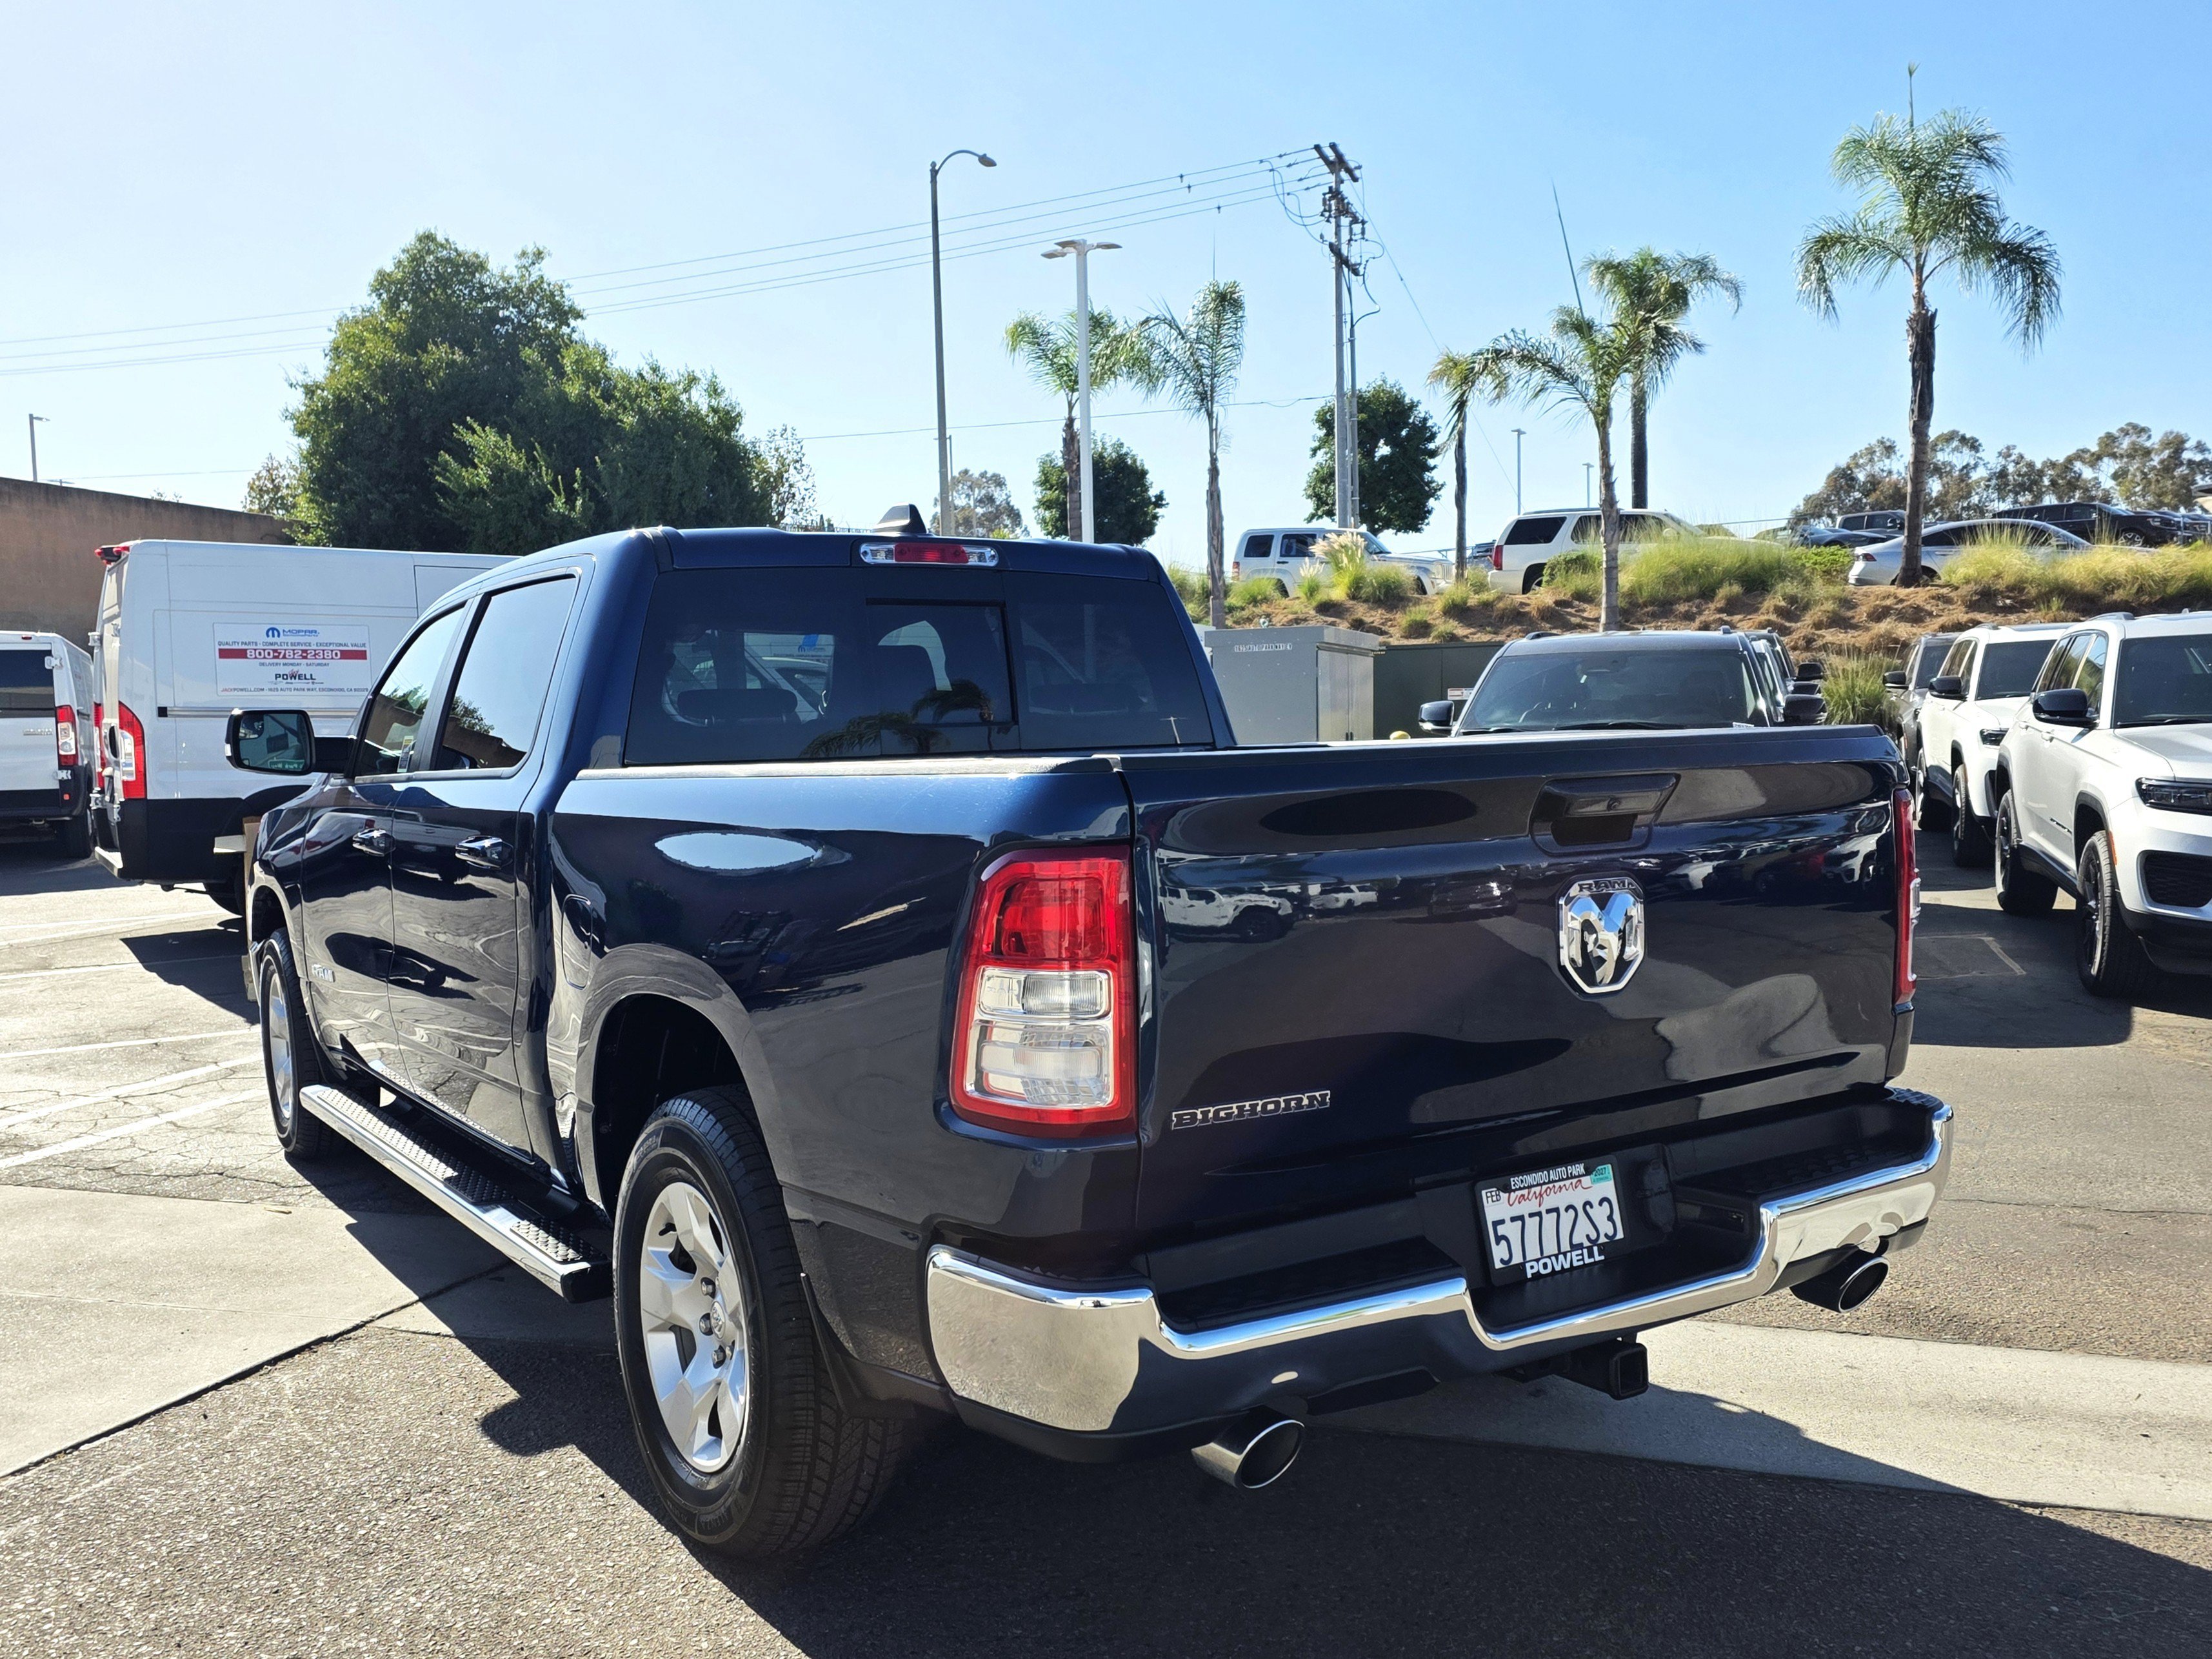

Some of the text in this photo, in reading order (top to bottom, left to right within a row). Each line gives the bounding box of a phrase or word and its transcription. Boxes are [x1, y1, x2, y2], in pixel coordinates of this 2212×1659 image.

[246, 649, 341, 659] 800-782-2380
[1577, 880, 1627, 892] RAM
[312, 964, 334, 982] RAM
[1510, 1163, 1586, 1190] ESCONDIDO AUTO PARK
[1486, 1190, 1502, 1205] FEB
[1507, 1178, 1593, 1208] California
[1491, 1196, 1618, 1266] 57772S3
[1526, 1245, 1605, 1279] POWELL
